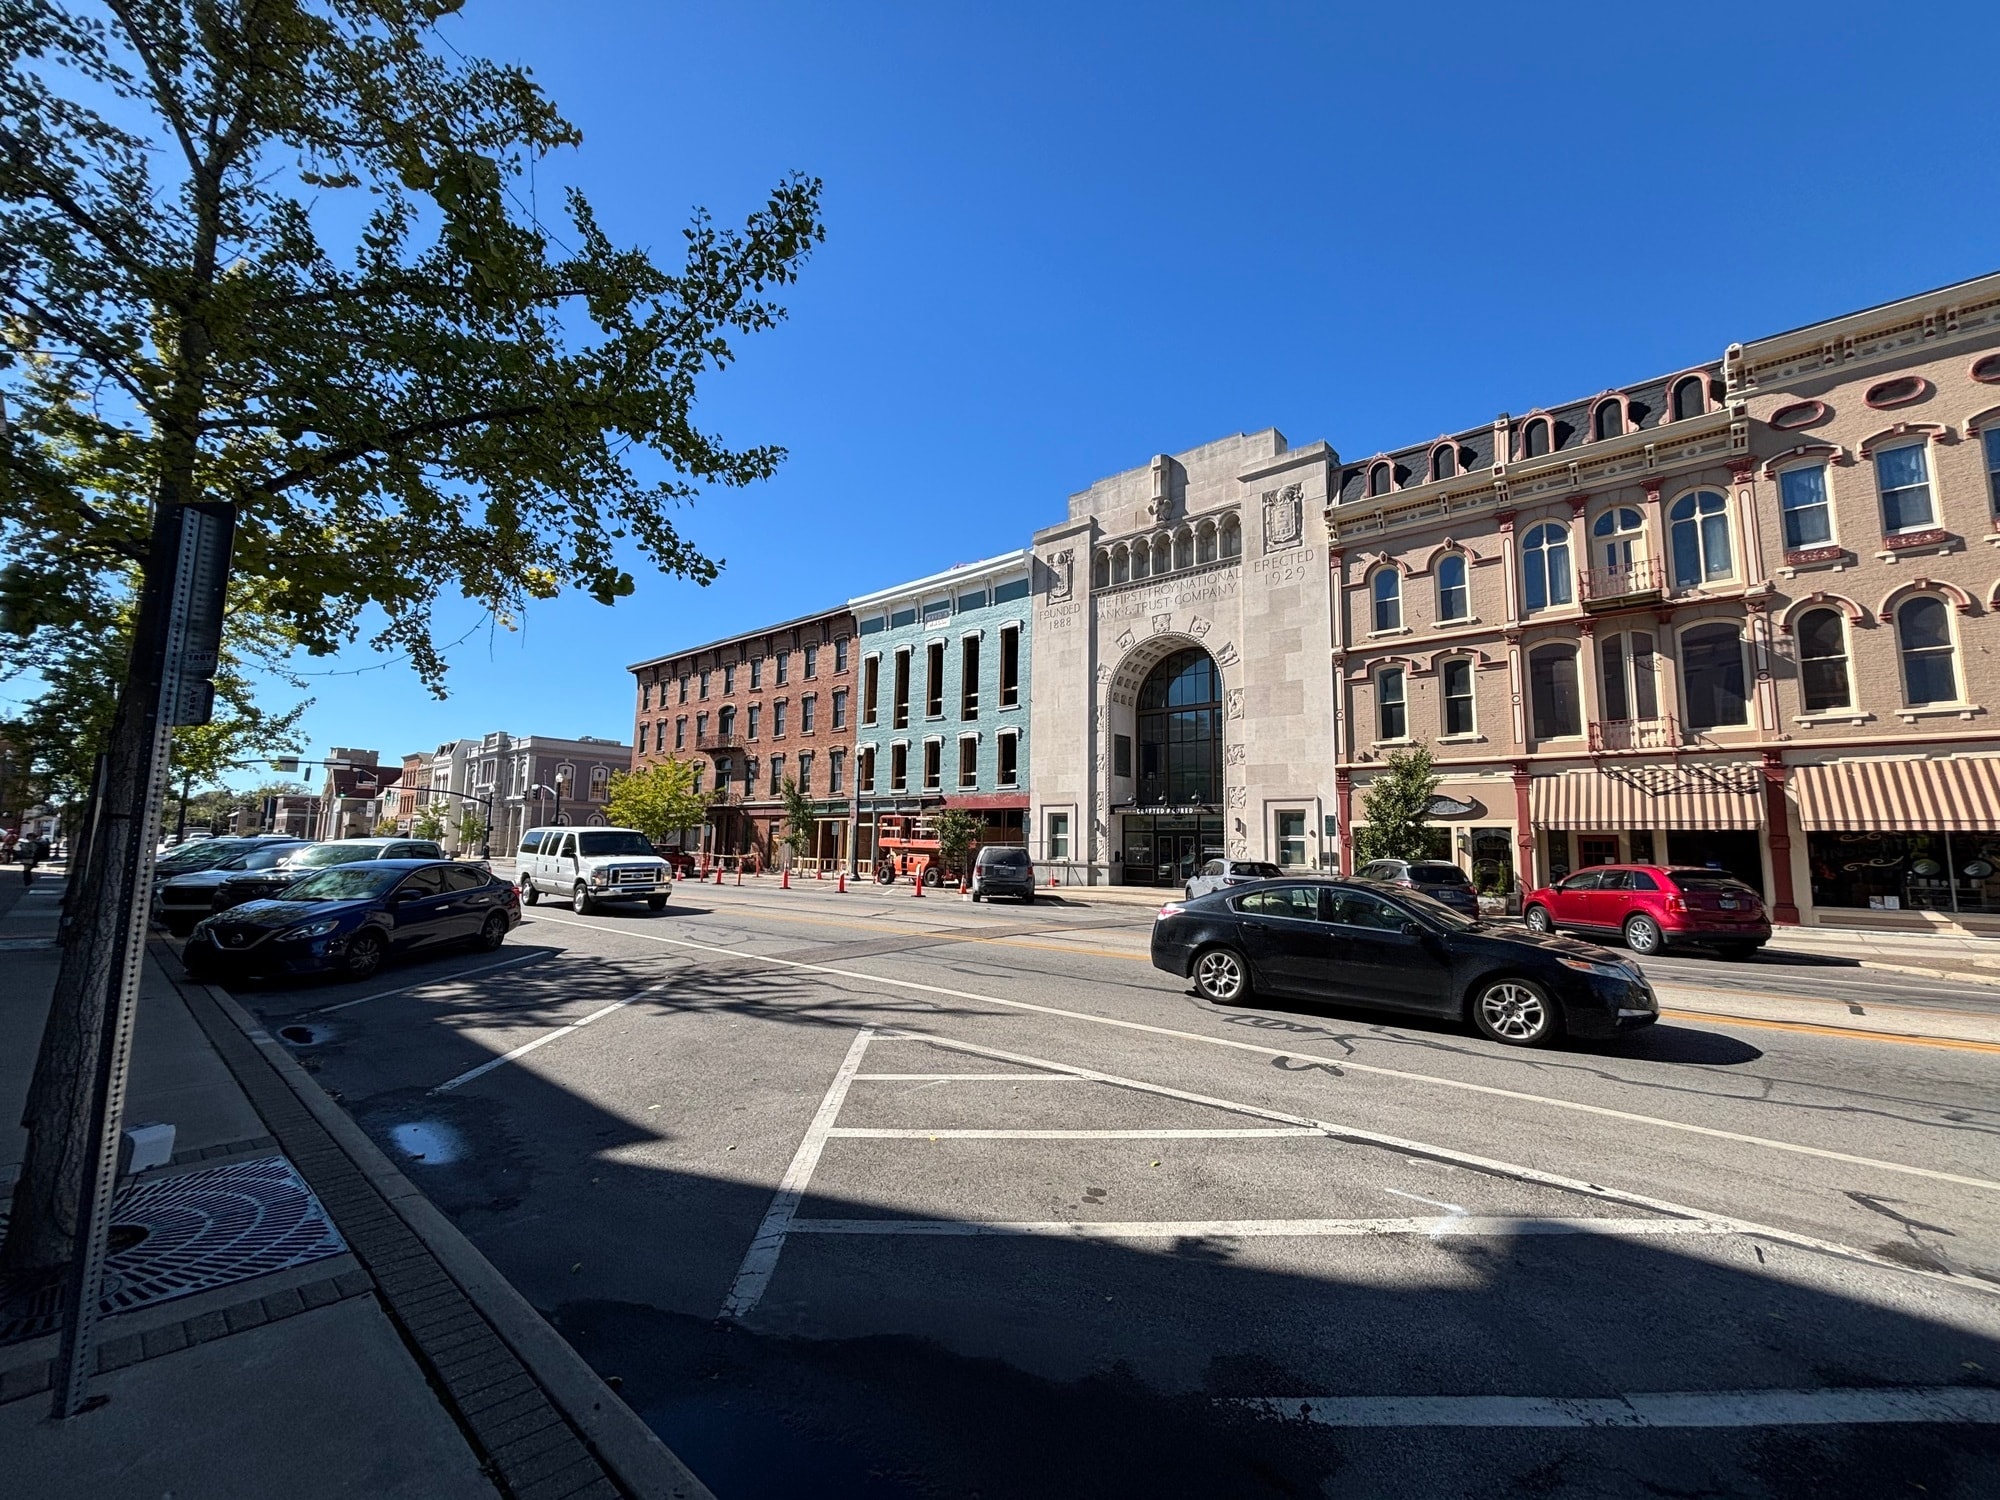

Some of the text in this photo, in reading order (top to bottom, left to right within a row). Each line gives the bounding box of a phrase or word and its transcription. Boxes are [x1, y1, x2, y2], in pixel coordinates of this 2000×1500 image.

[1254, 549, 1314, 573] ERECTED
[1265, 565, 1306, 585] 1929
[1098, 568, 1242, 609] HE FIRST TROY NATIONAL
[1135, 598, 1171, 614] TRUST
[1175, 581, 1238, 605] COMPANY
[1049, 616, 1072, 631] 1888
